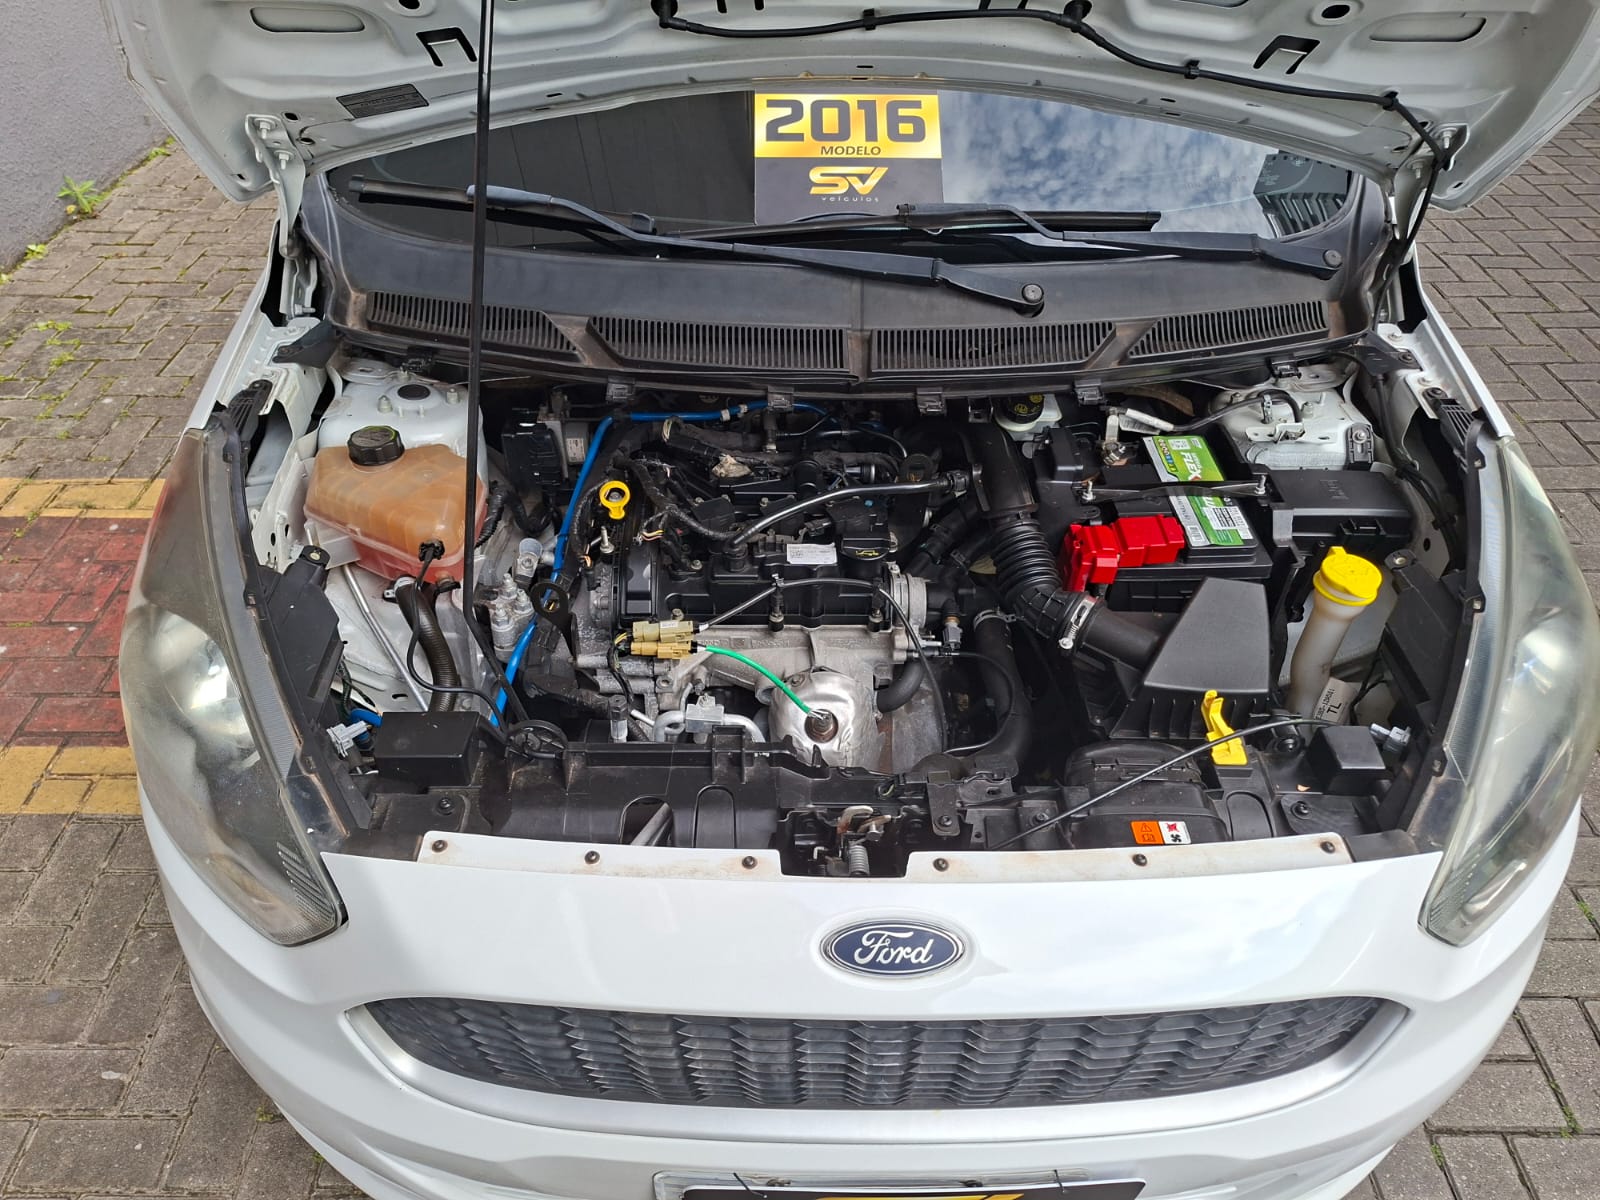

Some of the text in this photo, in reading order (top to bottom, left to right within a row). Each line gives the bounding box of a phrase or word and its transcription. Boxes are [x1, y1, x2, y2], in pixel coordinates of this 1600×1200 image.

[766, 99, 926, 142] 2016
[820, 146, 881, 156] MODELO
[809, 166, 889, 195] SV
[1326, 702, 1342, 714] TL
[854, 930, 934, 965] Ford
